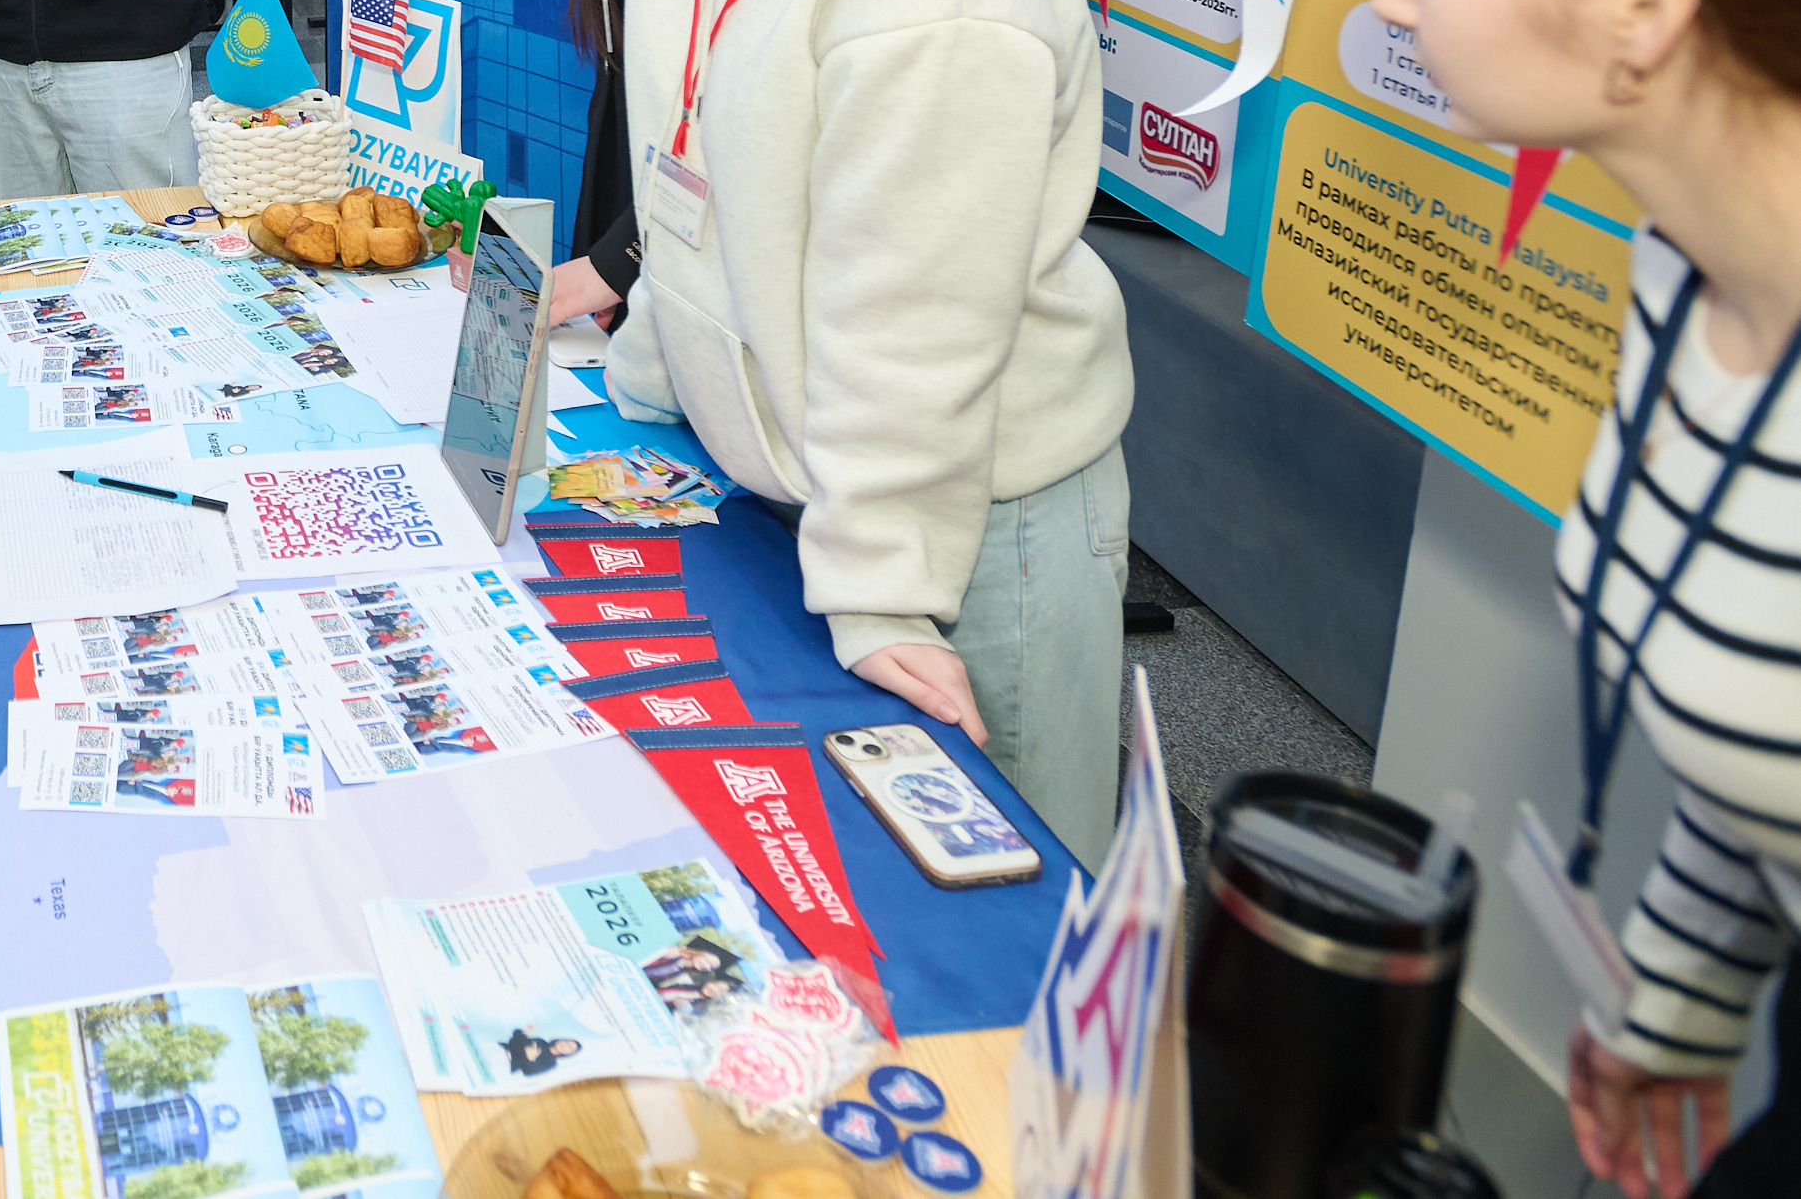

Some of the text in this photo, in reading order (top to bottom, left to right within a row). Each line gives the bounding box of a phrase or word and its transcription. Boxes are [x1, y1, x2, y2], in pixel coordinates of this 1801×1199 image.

[1382, 75, 1437, 109] статья
[1277, 217, 1411, 308] Малазийский
[1302, 168, 1315, 190] В
[1318, 181, 1392, 230] рамках
[1394, 220, 1477, 275] работы
[1482, 264, 1513, 293] по
[1324, 147, 1611, 303] University Putra alaysia
[227, 273, 256, 294] 2026
[233, 302, 263, 324] 2026
[1296, 200, 1417, 277] проводился
[1421, 268, 1496, 320] обмен
[1501, 310, 1602, 377] опытом
[257, 330, 290, 353] 2026
[1327, 281, 1551, 423] исследовательским
[1343, 322, 1517, 440] университетом
[49, 878, 67, 921] Texas
[744, 809, 816, 914] OF ARIZONA
[763, 797, 856, 927] THE UNIVERSITY
[585, 885, 641, 947] 2026
